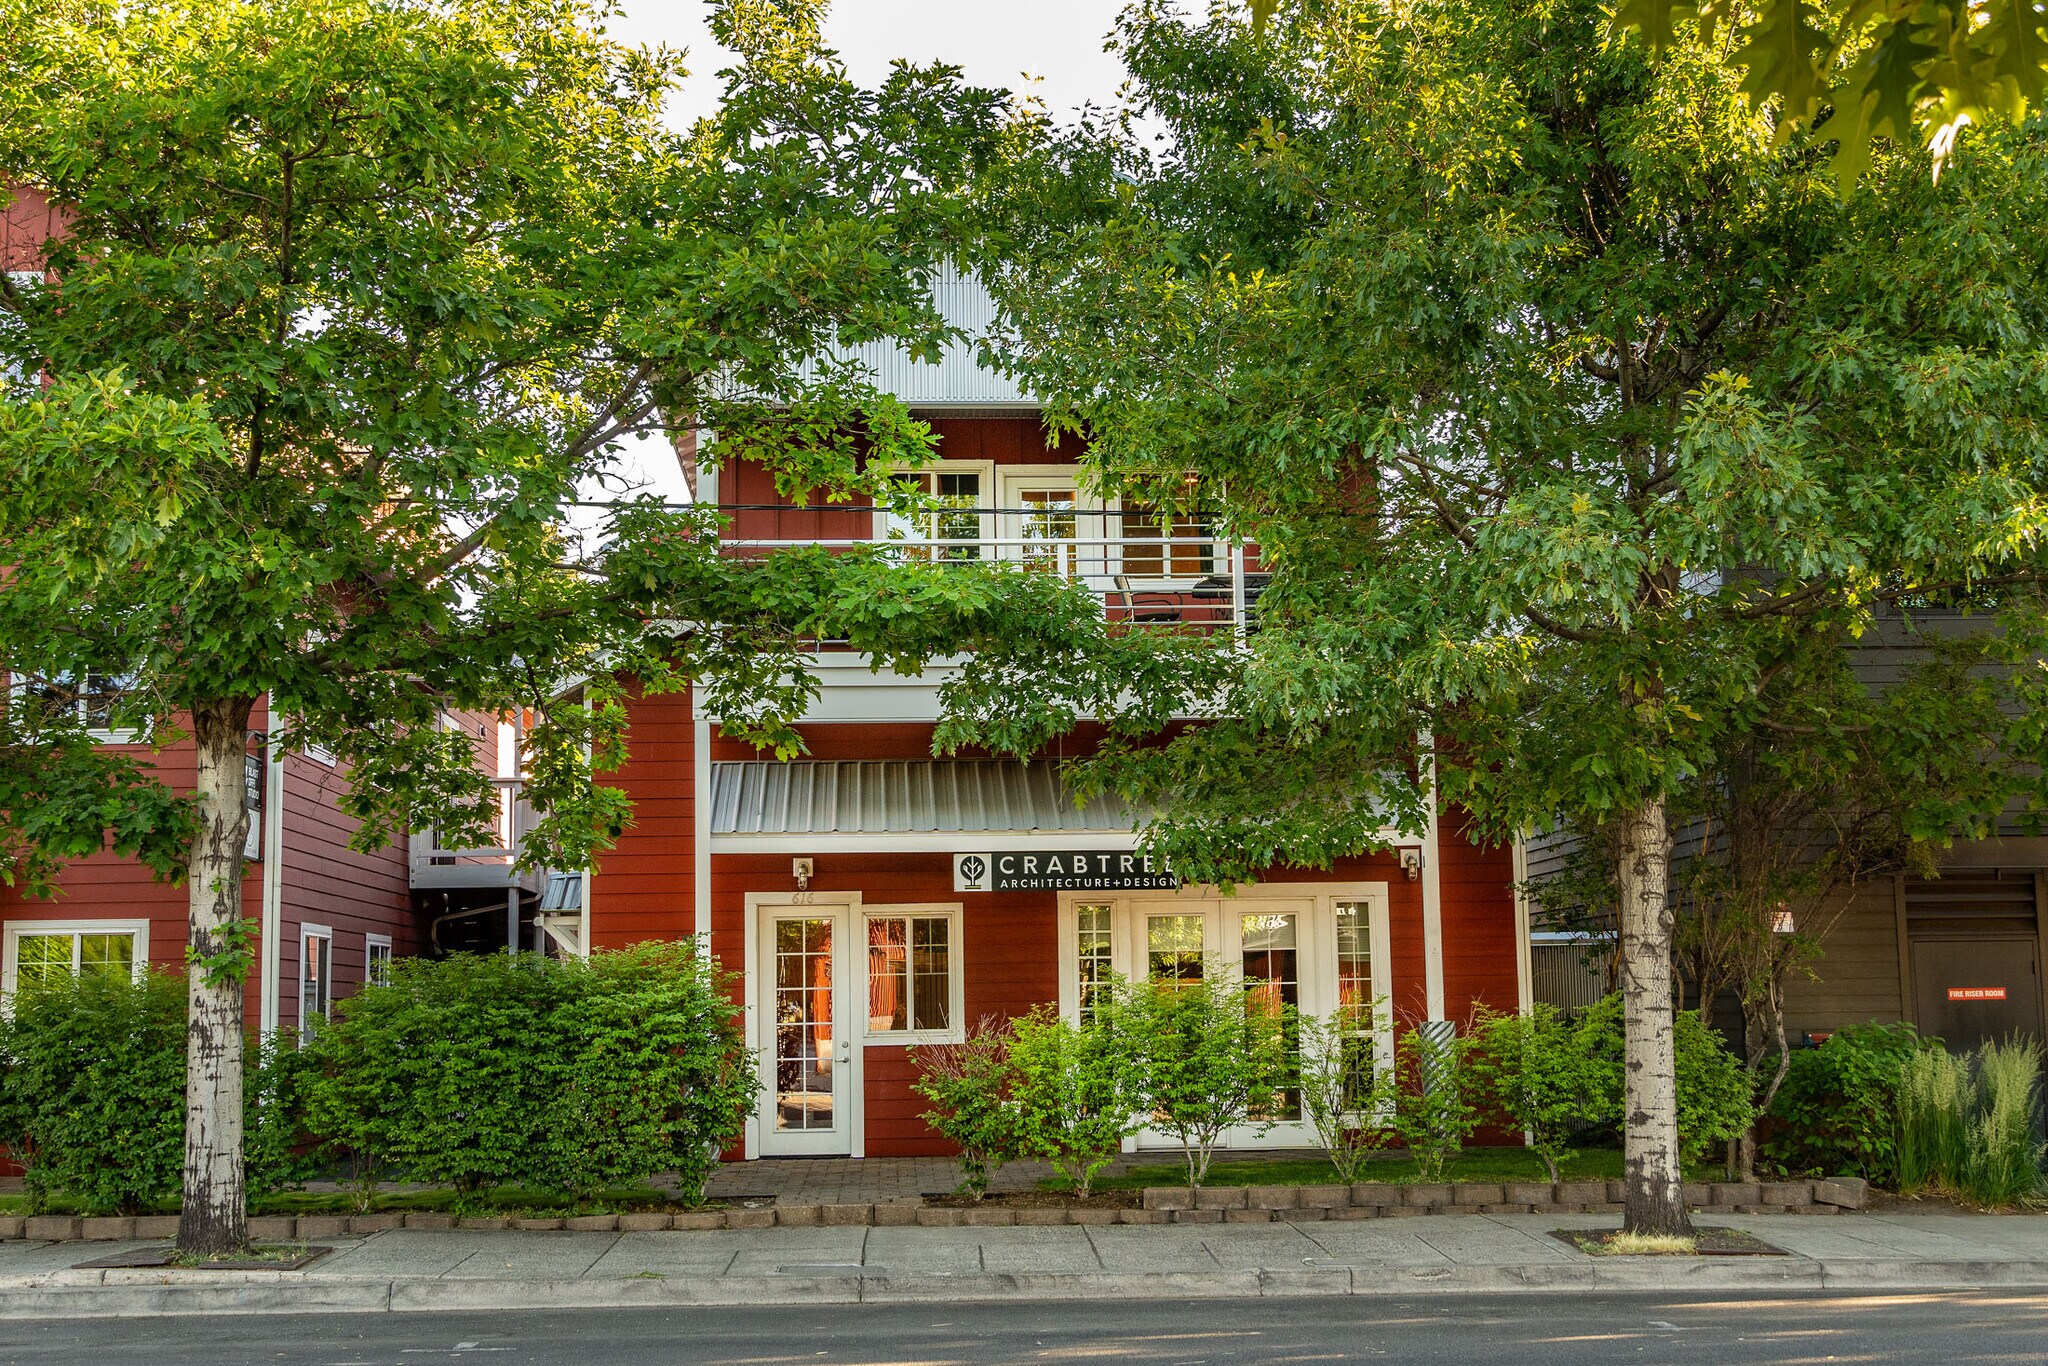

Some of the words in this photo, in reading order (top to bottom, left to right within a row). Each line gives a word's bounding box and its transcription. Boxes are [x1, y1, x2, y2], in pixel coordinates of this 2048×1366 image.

[247, 787, 260, 800] STUDIO
[792, 892, 814, 904] 616
[1949, 990, 1964, 998] FIRE
[1965, 990, 1984, 998] RISER
[1984, 989, 2004, 997] ROOM
